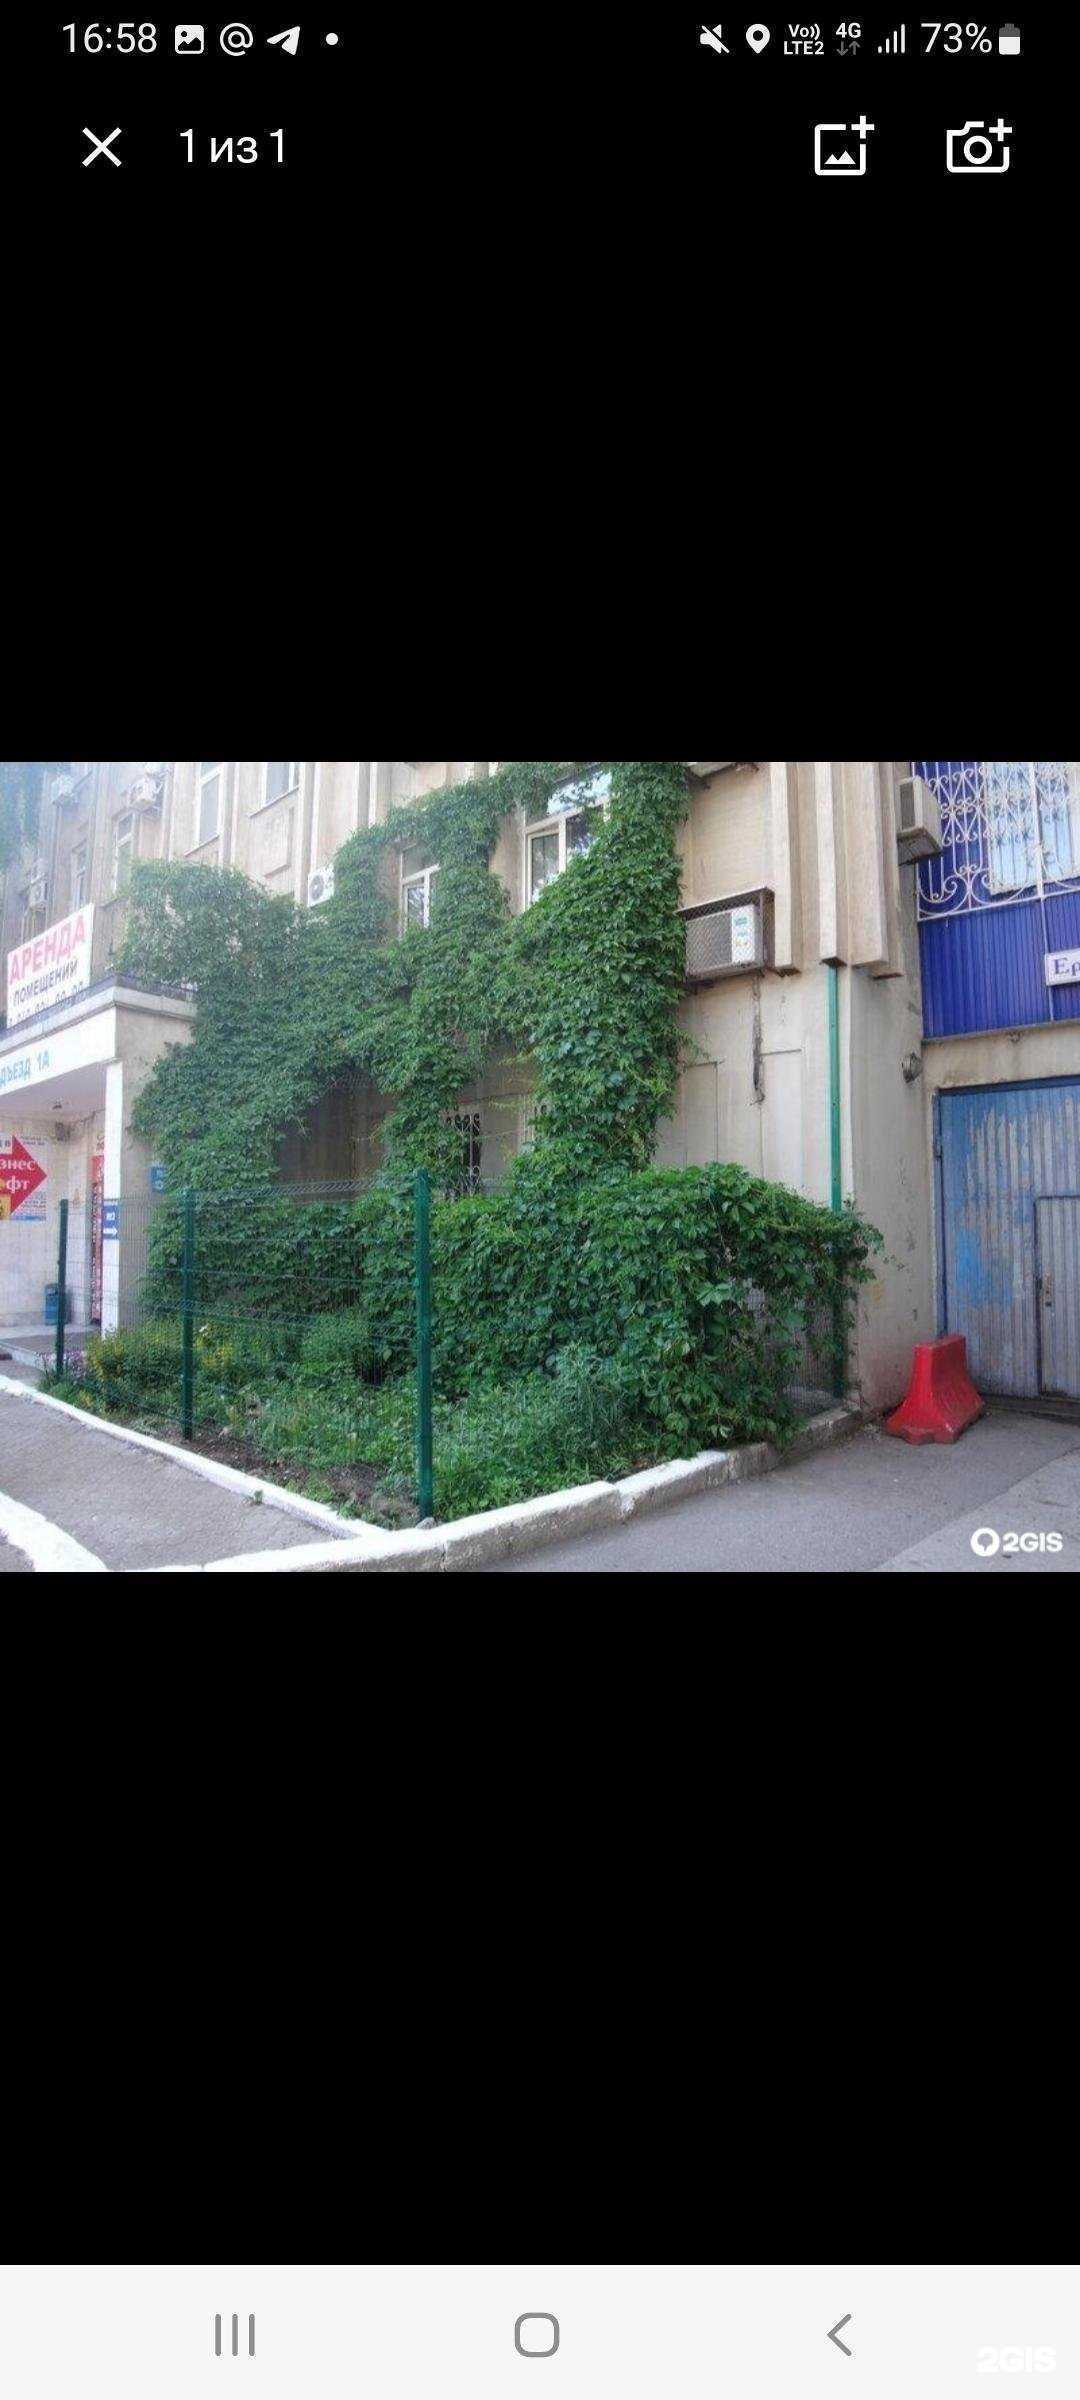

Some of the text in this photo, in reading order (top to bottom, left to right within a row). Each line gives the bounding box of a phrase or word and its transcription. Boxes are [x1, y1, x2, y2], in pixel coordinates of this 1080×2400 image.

[62, 22, 158, 54] 16:58
[835, 22, 862, 39] 4G
[920, 22, 993, 54] 73%
[783, 40, 825, 55] LTE2
[179, 128, 284, 164] 1 из 1
[10, 913, 86, 986] АРЕНДА
[13, 956, 80, 1006] ПОМЕЩЕНИЙ
